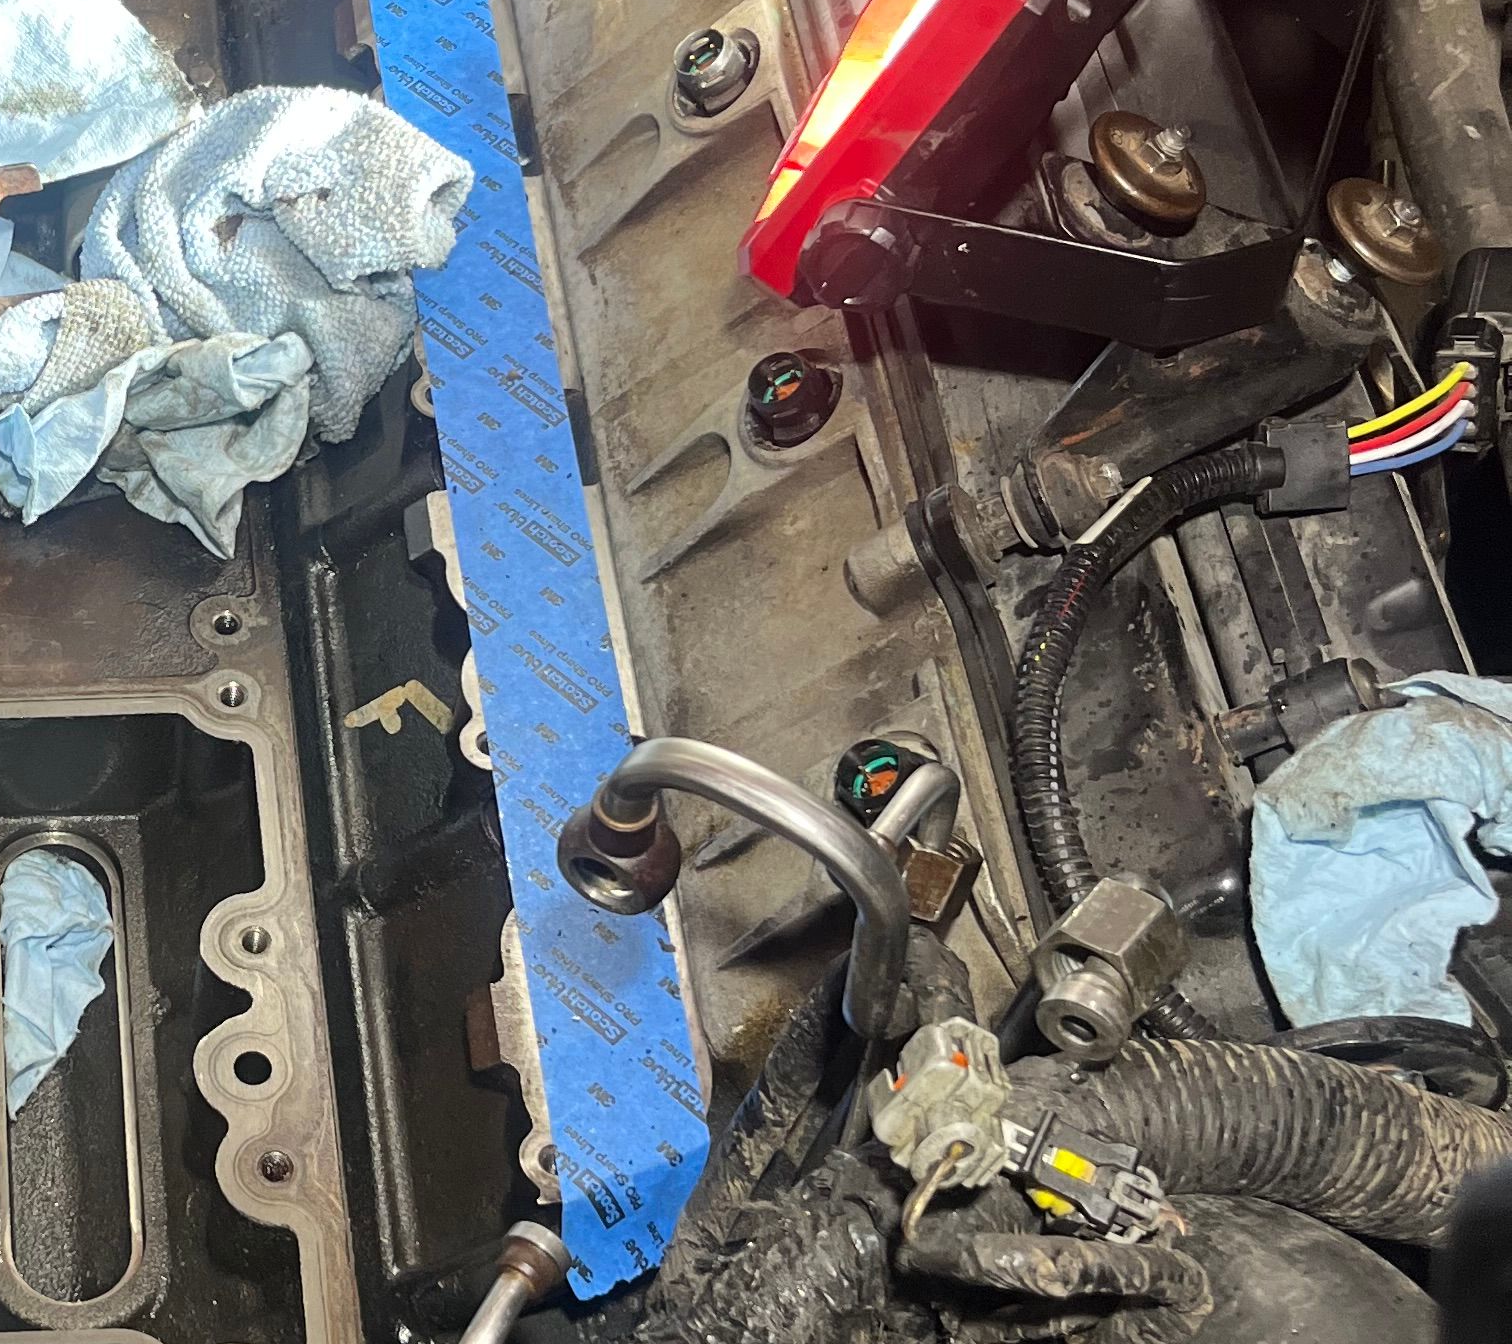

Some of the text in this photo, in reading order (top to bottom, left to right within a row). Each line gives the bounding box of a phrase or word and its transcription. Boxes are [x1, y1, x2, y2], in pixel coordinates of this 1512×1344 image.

[385, 1, 407, 17] 3M
[463, 10, 489, 33] blue
[435, 35, 456, 52] 3M
[387, 64, 456, 115] Scotch blue
[402, 53, 472, 105] PRO Sharp Lines
[470, 121, 498, 145] blue
[486, 111, 509, 130] Lines
[479, 174, 502, 192] 3M
[493, 228, 519, 249] Lines
[477, 239, 507, 265] blue
[478, 292, 502, 312] 3M
[436, 304, 466, 329] Sharp
[424, 319, 470, 356] Scotch
[464, 326, 487, 346] PRO
[534, 331, 557, 351] 3M
[500, 352, 558, 397] Sharp Lines
[484, 365, 563, 424] Scotch blue
[477, 410, 501, 432] 3M
[445, 436, 498, 480] PRO Sharp
[534, 453, 558, 474] 3M
[495, 500, 575, 563] Scotch blue
[512, 487, 593, 551] PRO Sharp Lines
[481, 540, 506, 562] 3M
[487, 598, 512, 620] PRO
[539, 585, 564, 608] 3M
[527, 628, 613, 698] PRO Sharp Lines
[510, 643, 594, 711] Scotch blue
[497, 748, 522, 771] PRO
[538, 781, 568, 806] Lines
[549, 947, 580, 974] Lines
[530, 962, 621, 1039] Scotch blue
[615, 1001, 640, 1024] PRO
[658, 1038, 690, 1067] Lines
[639, 1054, 676, 1091] blue
[587, 1081, 616, 1109] 3M
[564, 1122, 645, 1210] PRO Sharp Lines
[656, 1139, 683, 1167] 3M
[578, 1172, 621, 1223] Scotch
[644, 1220, 665, 1247] Lines
